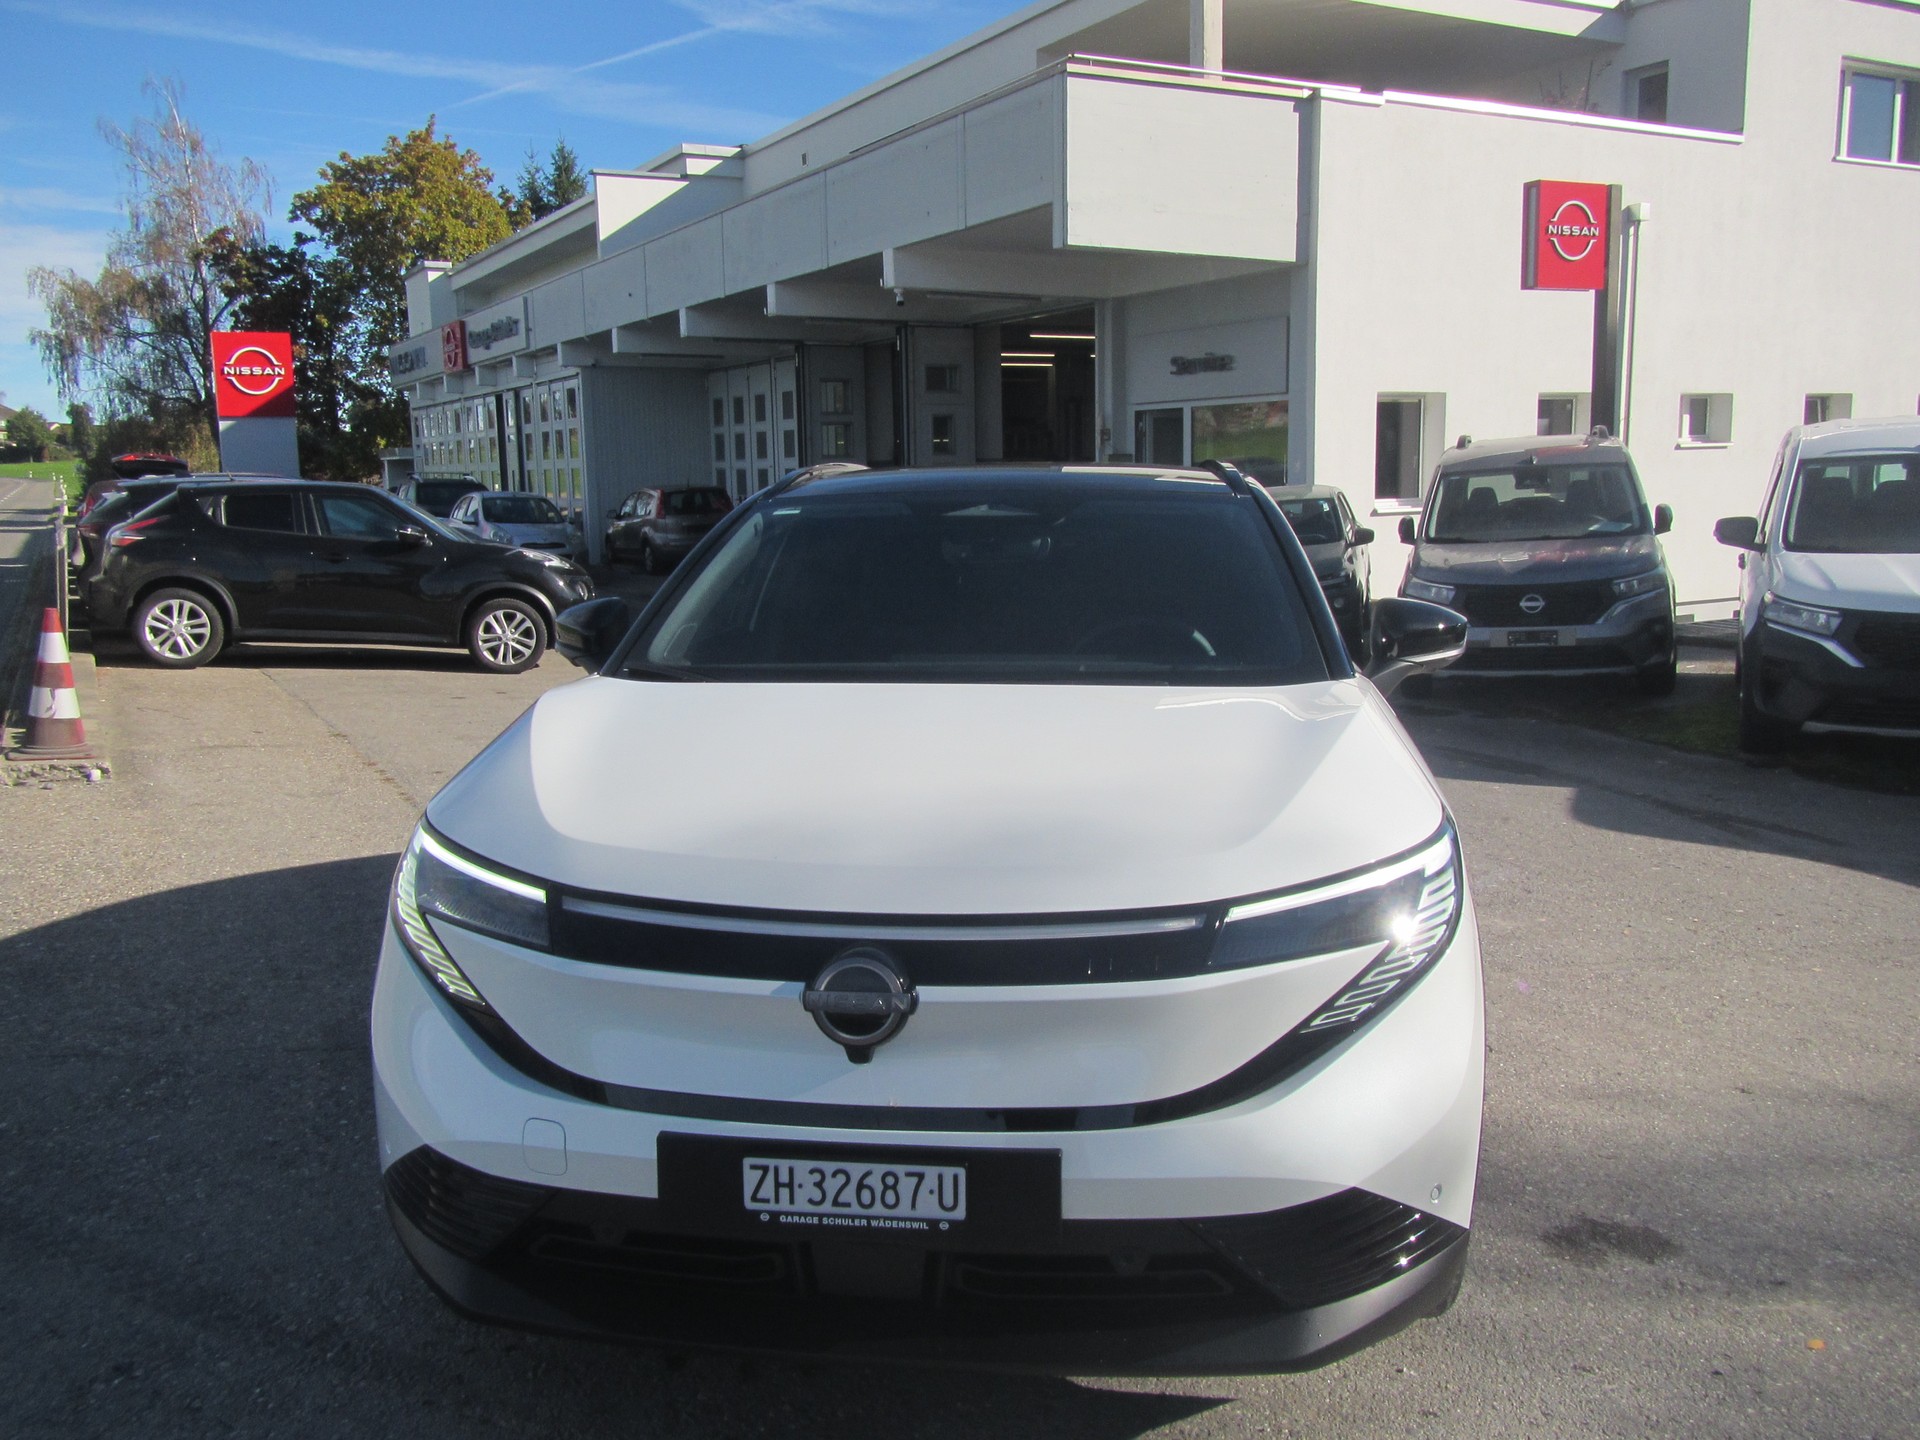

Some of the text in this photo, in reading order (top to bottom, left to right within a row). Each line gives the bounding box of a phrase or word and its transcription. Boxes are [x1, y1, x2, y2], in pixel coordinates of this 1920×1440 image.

[1548, 225, 1599, 236] NISSAN
[223, 366, 285, 375] NISSAN
[779, 1215, 929, 1230] GARAGE SCHULER WÄDENSWIL
